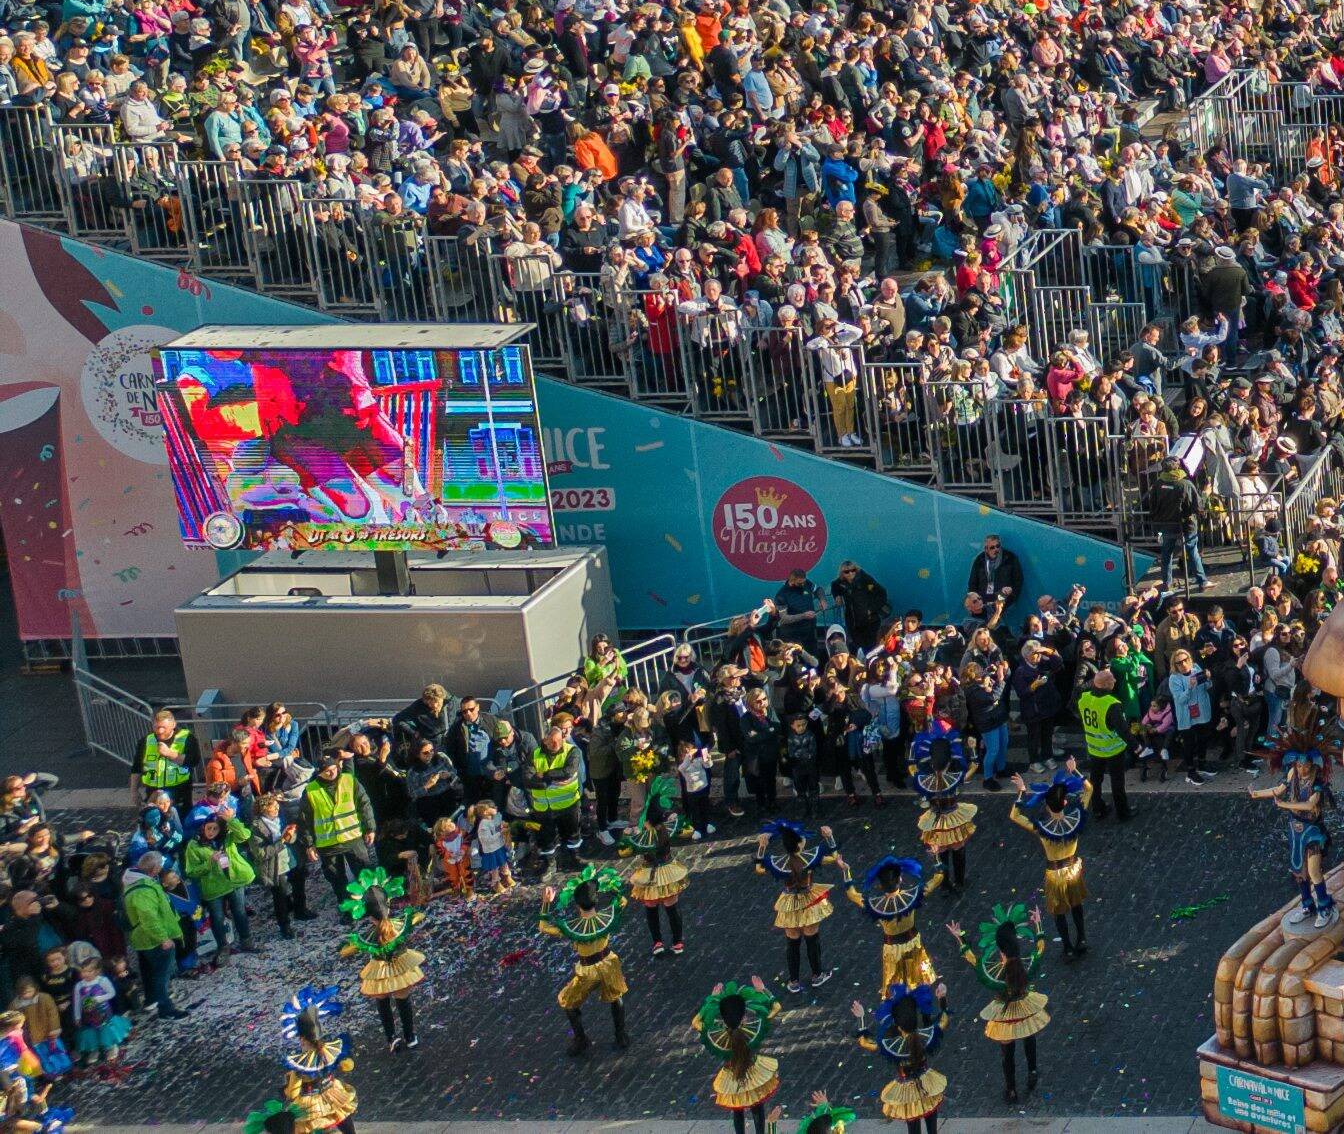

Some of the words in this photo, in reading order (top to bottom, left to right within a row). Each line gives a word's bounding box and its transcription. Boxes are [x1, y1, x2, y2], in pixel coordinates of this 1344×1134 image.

[127, 391, 140, 404] DE
[550, 489, 611, 509] 2023
[724, 503, 779, 530] 150
[782, 515, 817, 528] ANS
[720, 527, 818, 564] Majesté
[1083, 707, 1099, 729] 68
